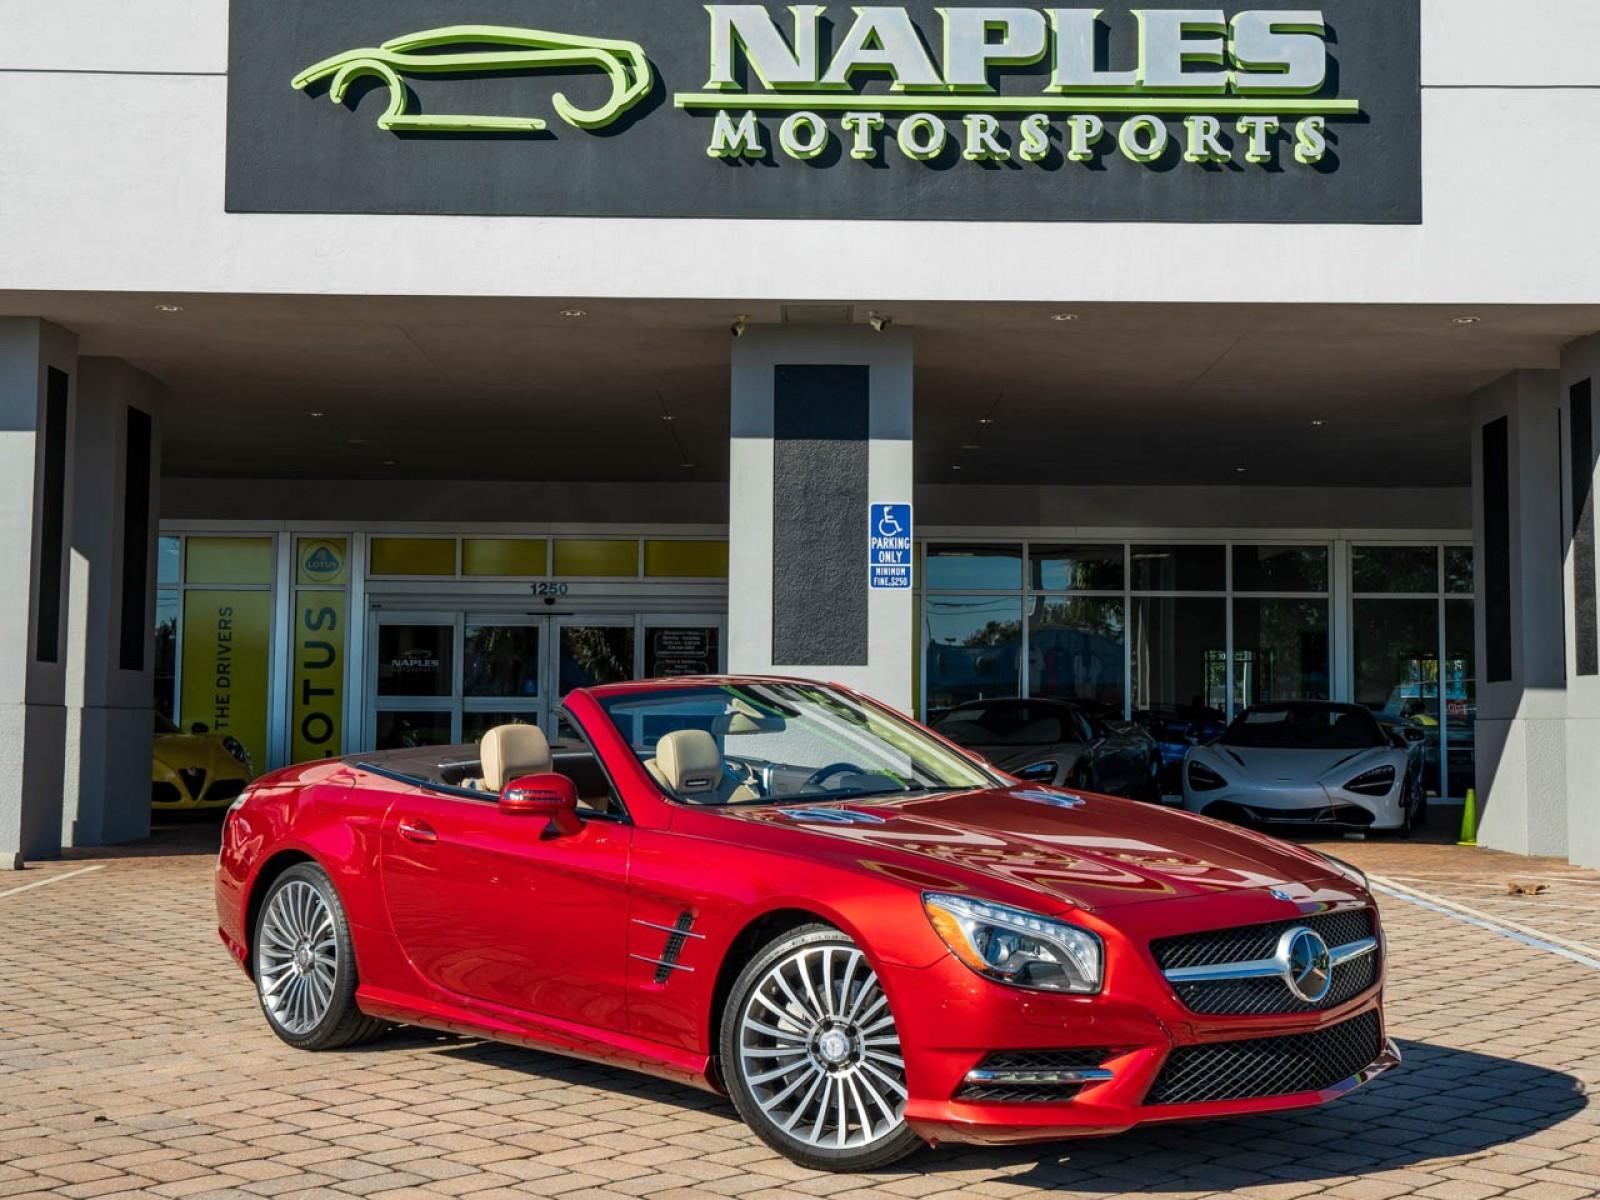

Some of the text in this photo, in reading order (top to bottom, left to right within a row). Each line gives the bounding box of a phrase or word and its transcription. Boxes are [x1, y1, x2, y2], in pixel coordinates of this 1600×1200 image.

[702, 5, 1326, 95] NAPLES
[706, 109, 1326, 164] MOTORSPORTS
[872, 537, 910, 549] PARKING
[879, 551, 903, 563] ONLY
[308, 561, 337, 569] LOTUS
[875, 567, 906, 576] MINIMUM
[530, 583, 568, 596] 1250
[215, 606, 233, 730] THE DRIVERS
[391, 659, 440, 667] NAPLES
[302, 607, 337, 758] OTUS
